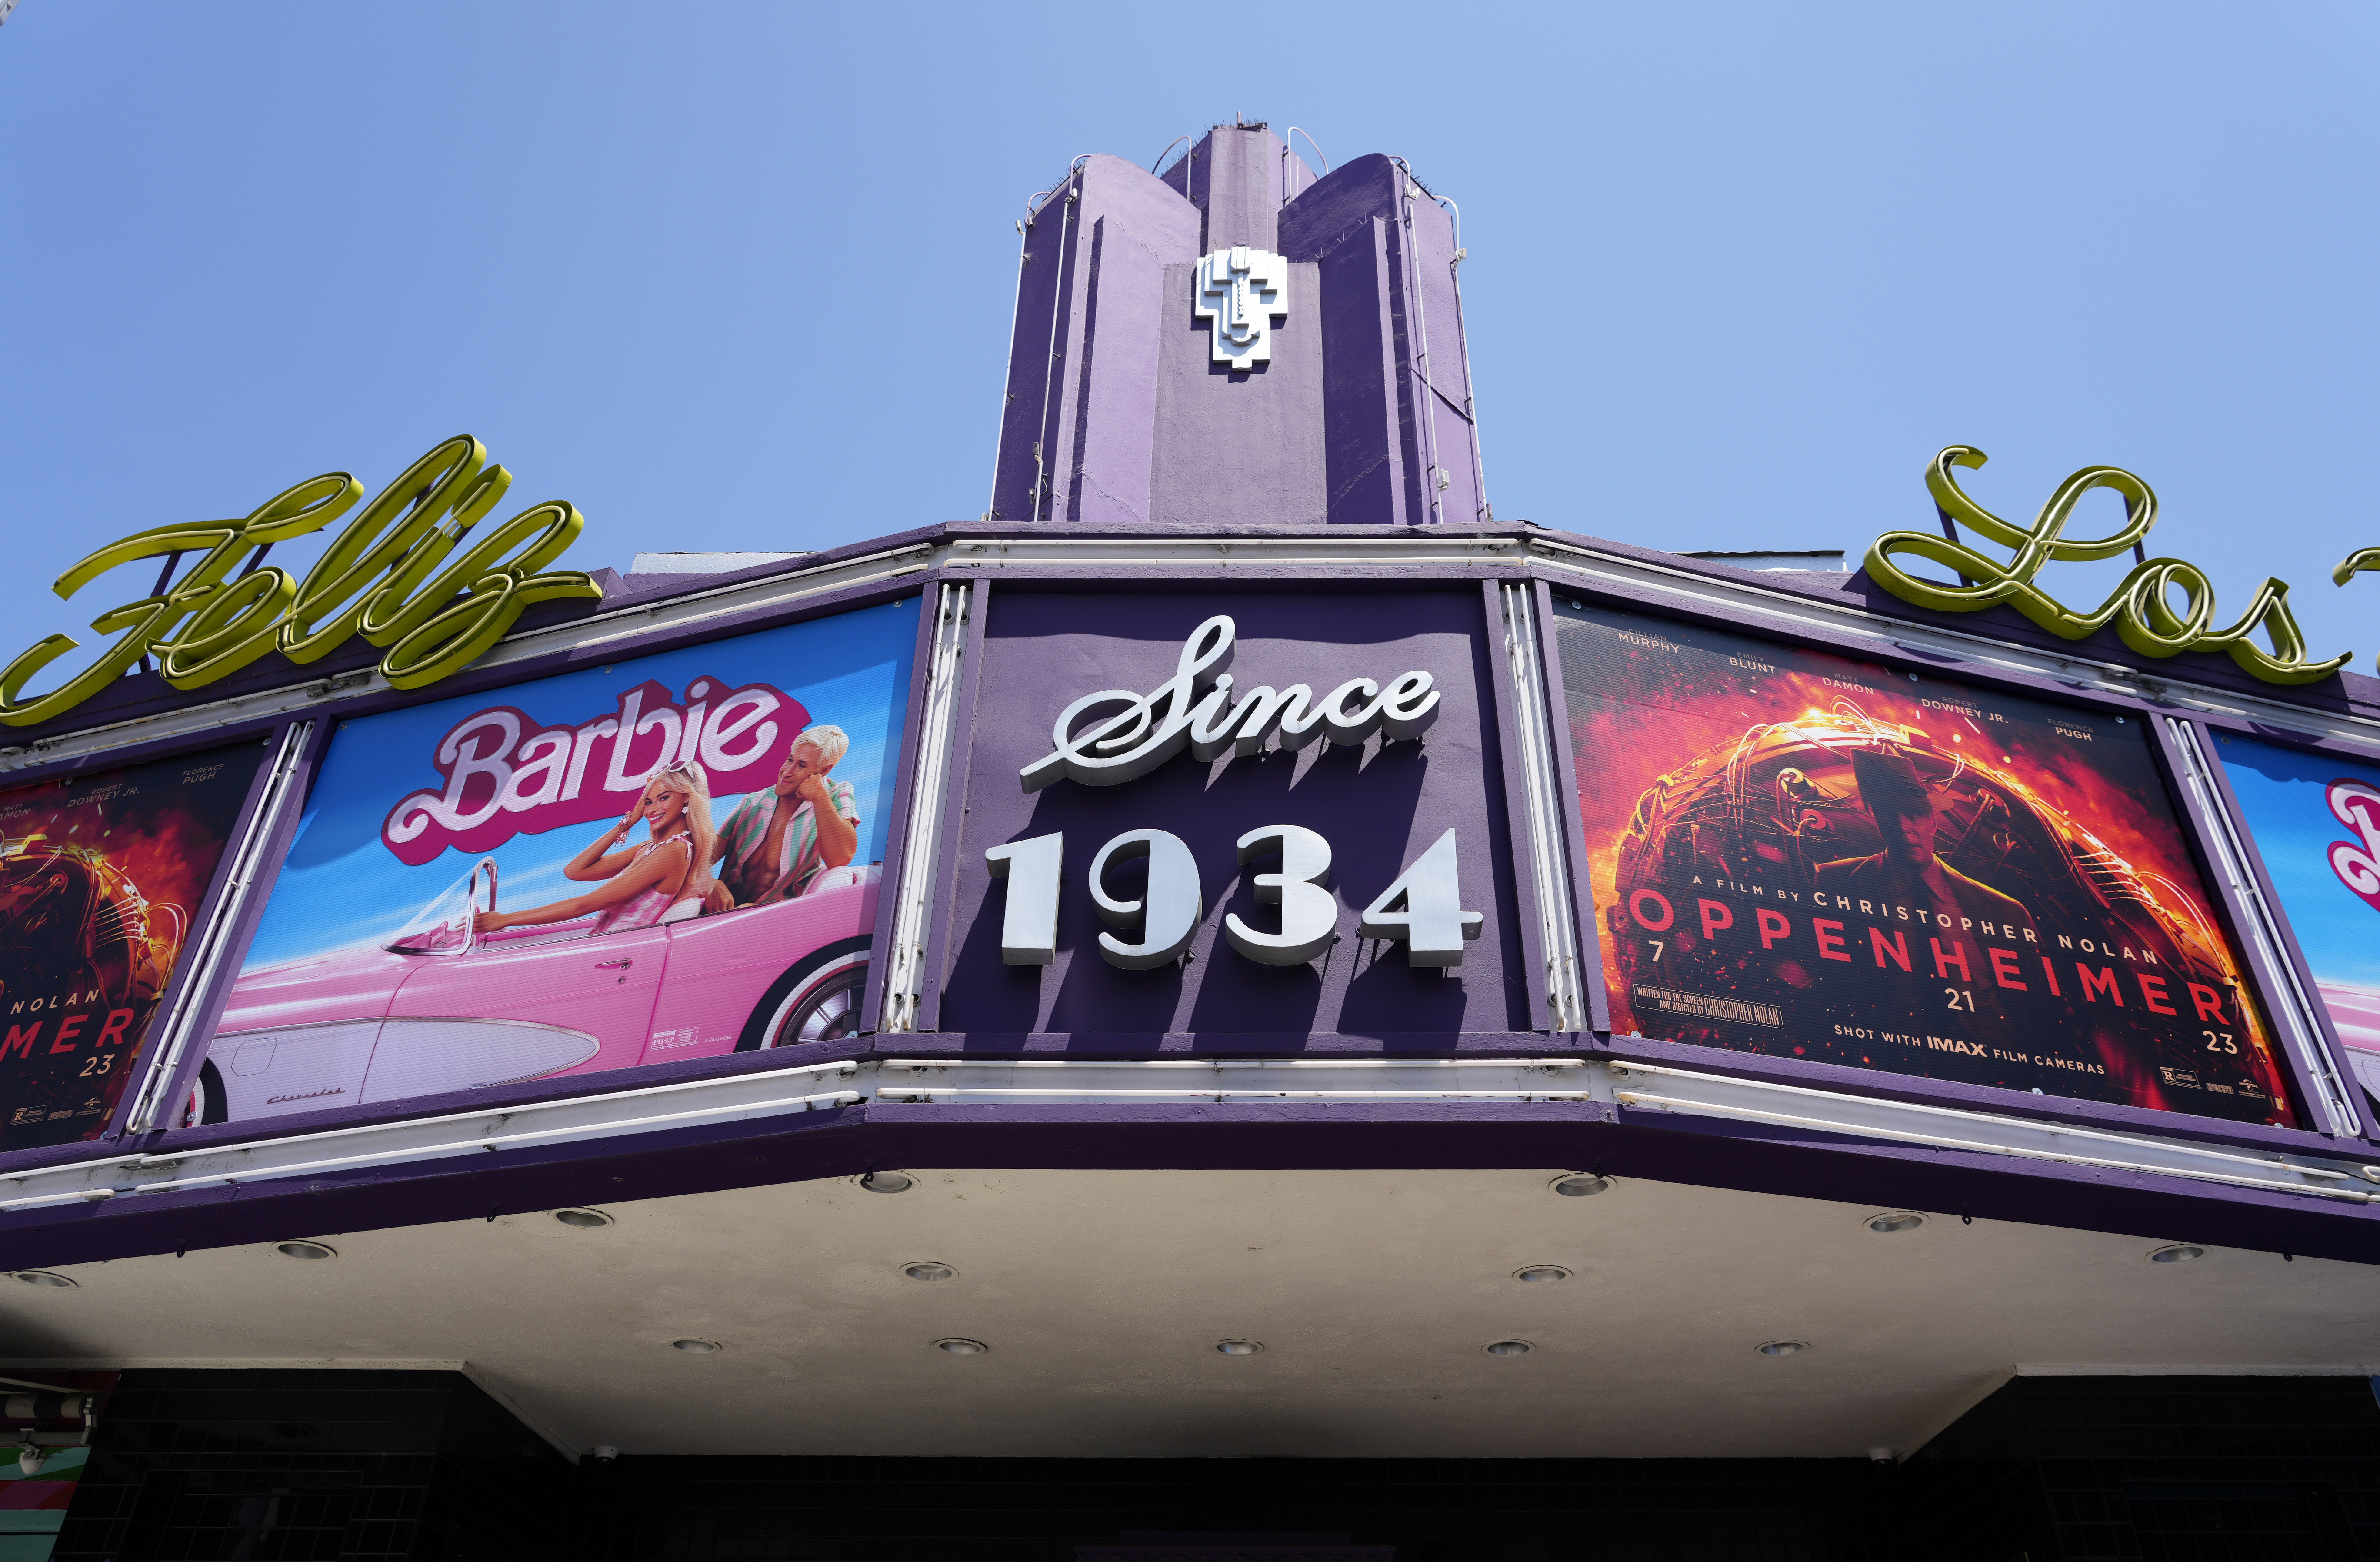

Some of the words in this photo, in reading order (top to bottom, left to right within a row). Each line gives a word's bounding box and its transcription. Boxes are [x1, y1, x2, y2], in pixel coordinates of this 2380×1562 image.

[1864, 444, 2353, 684] Los
[0, 434, 603, 726] Feliz
[1619, 633, 1679, 653] MURPHY
[1628, 629, 1667, 641] CILLIAN
[1729, 657, 1775, 674] BLUNT
[1737, 652, 1764, 663] EMILY
[1823, 677, 1874, 695] DAMON
[1833, 673, 1858, 683] MATT
[1019, 615, 1440, 794] Since
[1921, 698, 1981, 718] DOWNEY
[1988, 713, 2009, 724] JR.
[1942, 696, 1978, 708] ROBERT
[2047, 718, 2093, 733] FLORENCE
[2055, 727, 2092, 741] PUGH
[182, 764, 224, 777] FLORENCE
[388, 681, 781, 843] Barbie
[183, 771, 216, 784] PUGH
[67, 790, 121, 807] DOWNEY
[123, 787, 140, 796] JR.
[91, 784, 122, 794] ROBERT
[3, 803, 24, 812] MATT
[984, 824, 1483, 970] 1934
[1693, 875, 1703, 885] A
[1717, 879, 1763, 896] FILM
[1778, 890, 1799, 901] BY
[1813, 891, 2037, 943] CHRISTOPHER
[2057, 934, 2158, 964] NOLAN
[1629, 888, 2230, 1025] OPPENHEIMER
[1648, 940, 1664, 962] 7
[10, 989, 100, 1015] NOLAN
[1637, 987, 1660, 999] WRITTEN
[1661, 991, 1672, 1001] FOR
[1673, 993, 1682, 1003] THE
[1683, 995, 1703, 1005] SCREEN
[1944, 988, 1975, 1012] 21
[1660, 1000, 1671, 1010] AND
[1672, 1002, 1696, 1013] DIRECTED
[1697, 1006, 1704, 1015] BY
[1704, 998, 1753, 1022] CHRISTOPHER
[1753, 1005, 1780, 1026] NOLAN
[1834, 1025, 1874, 1040] SHOT
[1881, 1031, 1921, 1047] WITH
[1927, 1035, 1988, 1058] IMAX
[1994, 1049, 2028, 1063] FILM
[2034, 1055, 2105, 1075] CAMERAS
[2202, 1030, 2238, 1055] 23
[79, 1054, 115, 1077] 23
[2163, 1071, 2175, 1081] R
[13, 1112, 23, 1121] R
